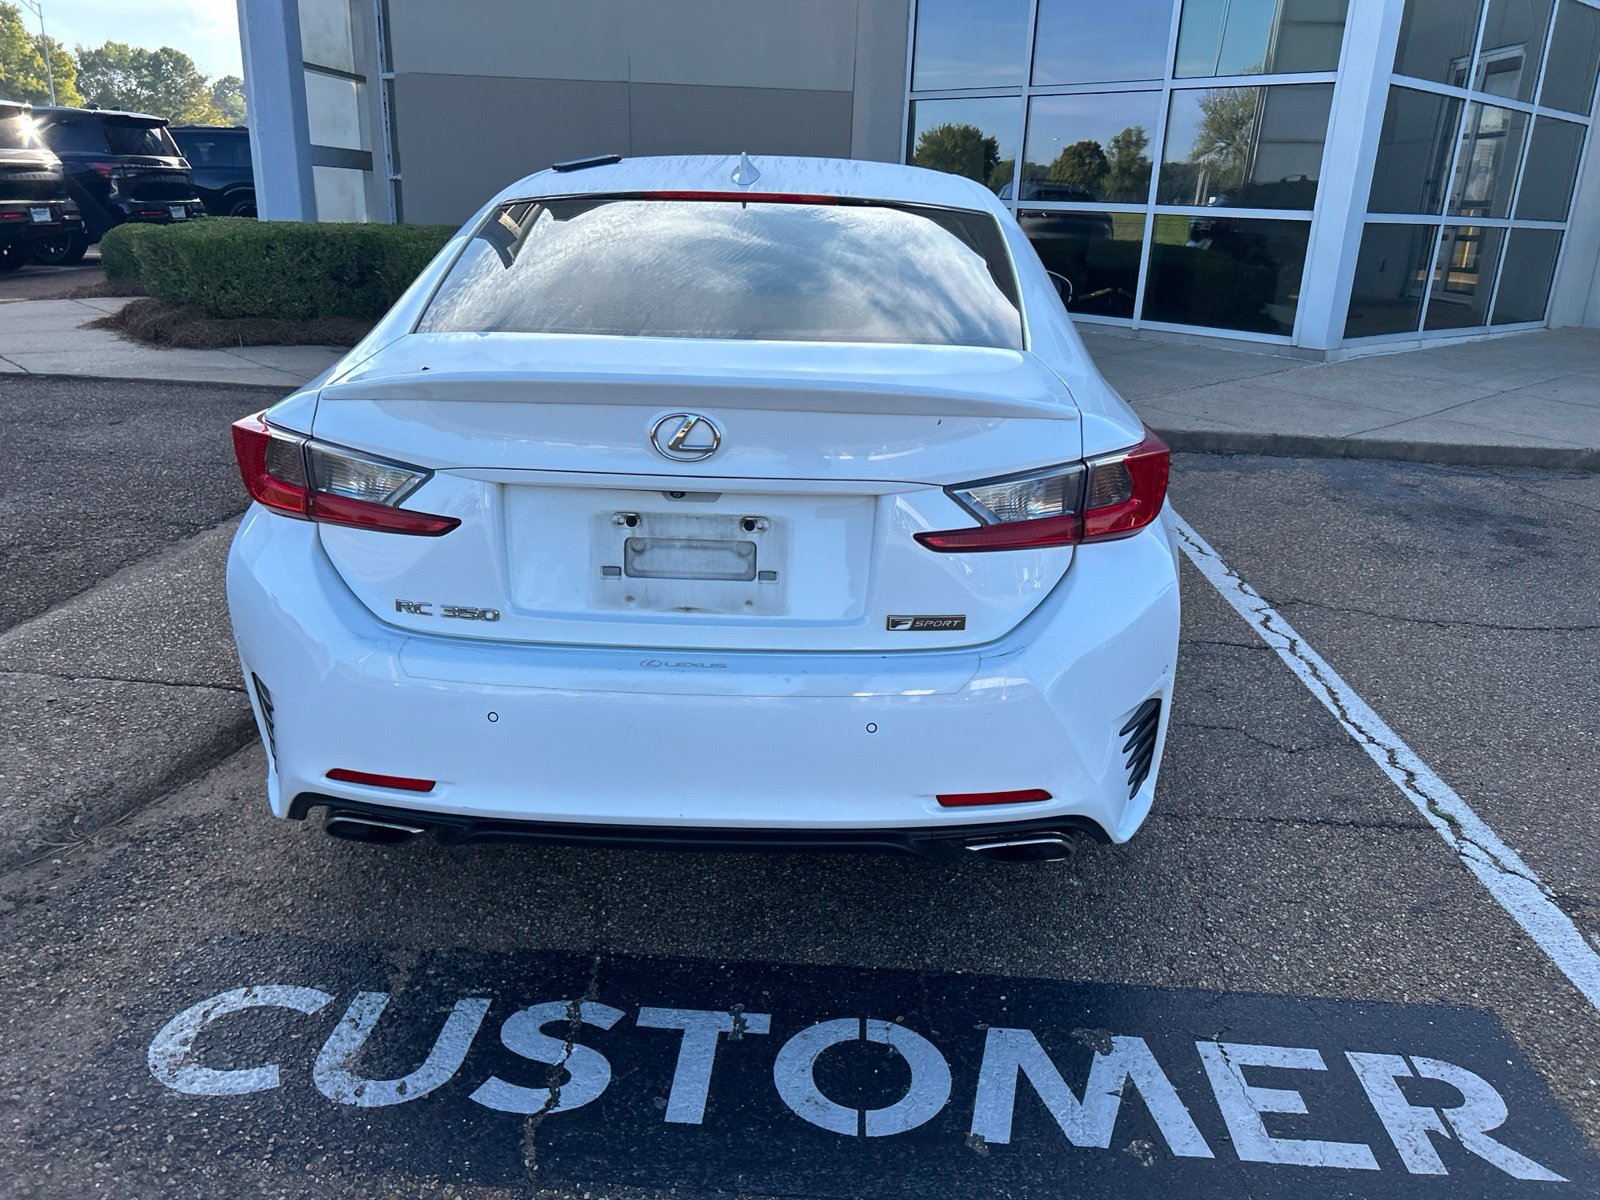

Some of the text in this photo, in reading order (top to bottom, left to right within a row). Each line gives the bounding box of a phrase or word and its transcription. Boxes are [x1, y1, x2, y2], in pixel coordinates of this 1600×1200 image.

[395, 599, 500, 622] RC 350
[664, 661, 728, 669] LEXUS
[148, 984, 1570, 1182] CUSTOMER
